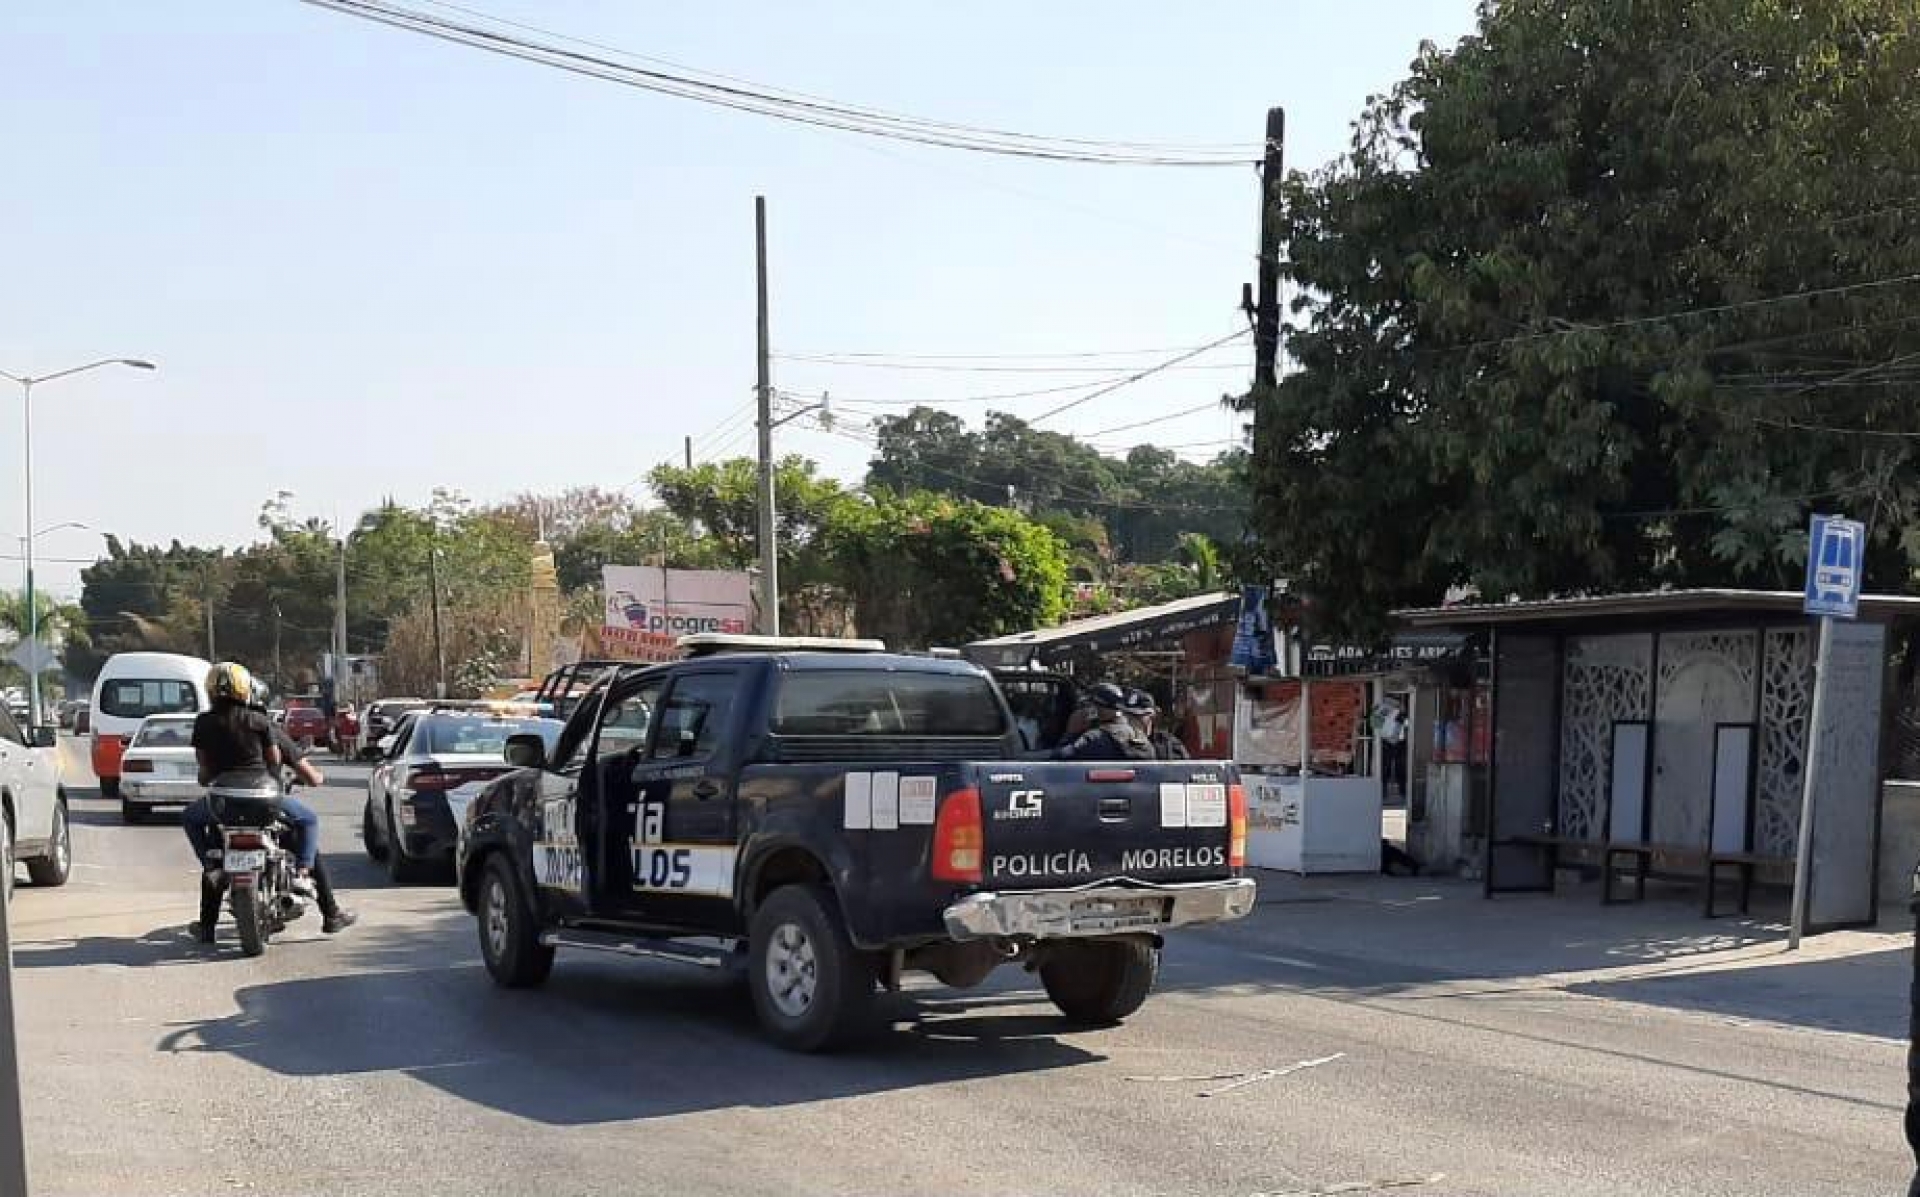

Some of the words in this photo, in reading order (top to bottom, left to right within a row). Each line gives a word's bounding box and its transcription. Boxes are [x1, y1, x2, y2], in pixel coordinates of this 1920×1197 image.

[651, 615, 744, 635] progresa
[993, 849, 1091, 877] POLICÍA
[1121, 846, 1225, 871] MORELOS
